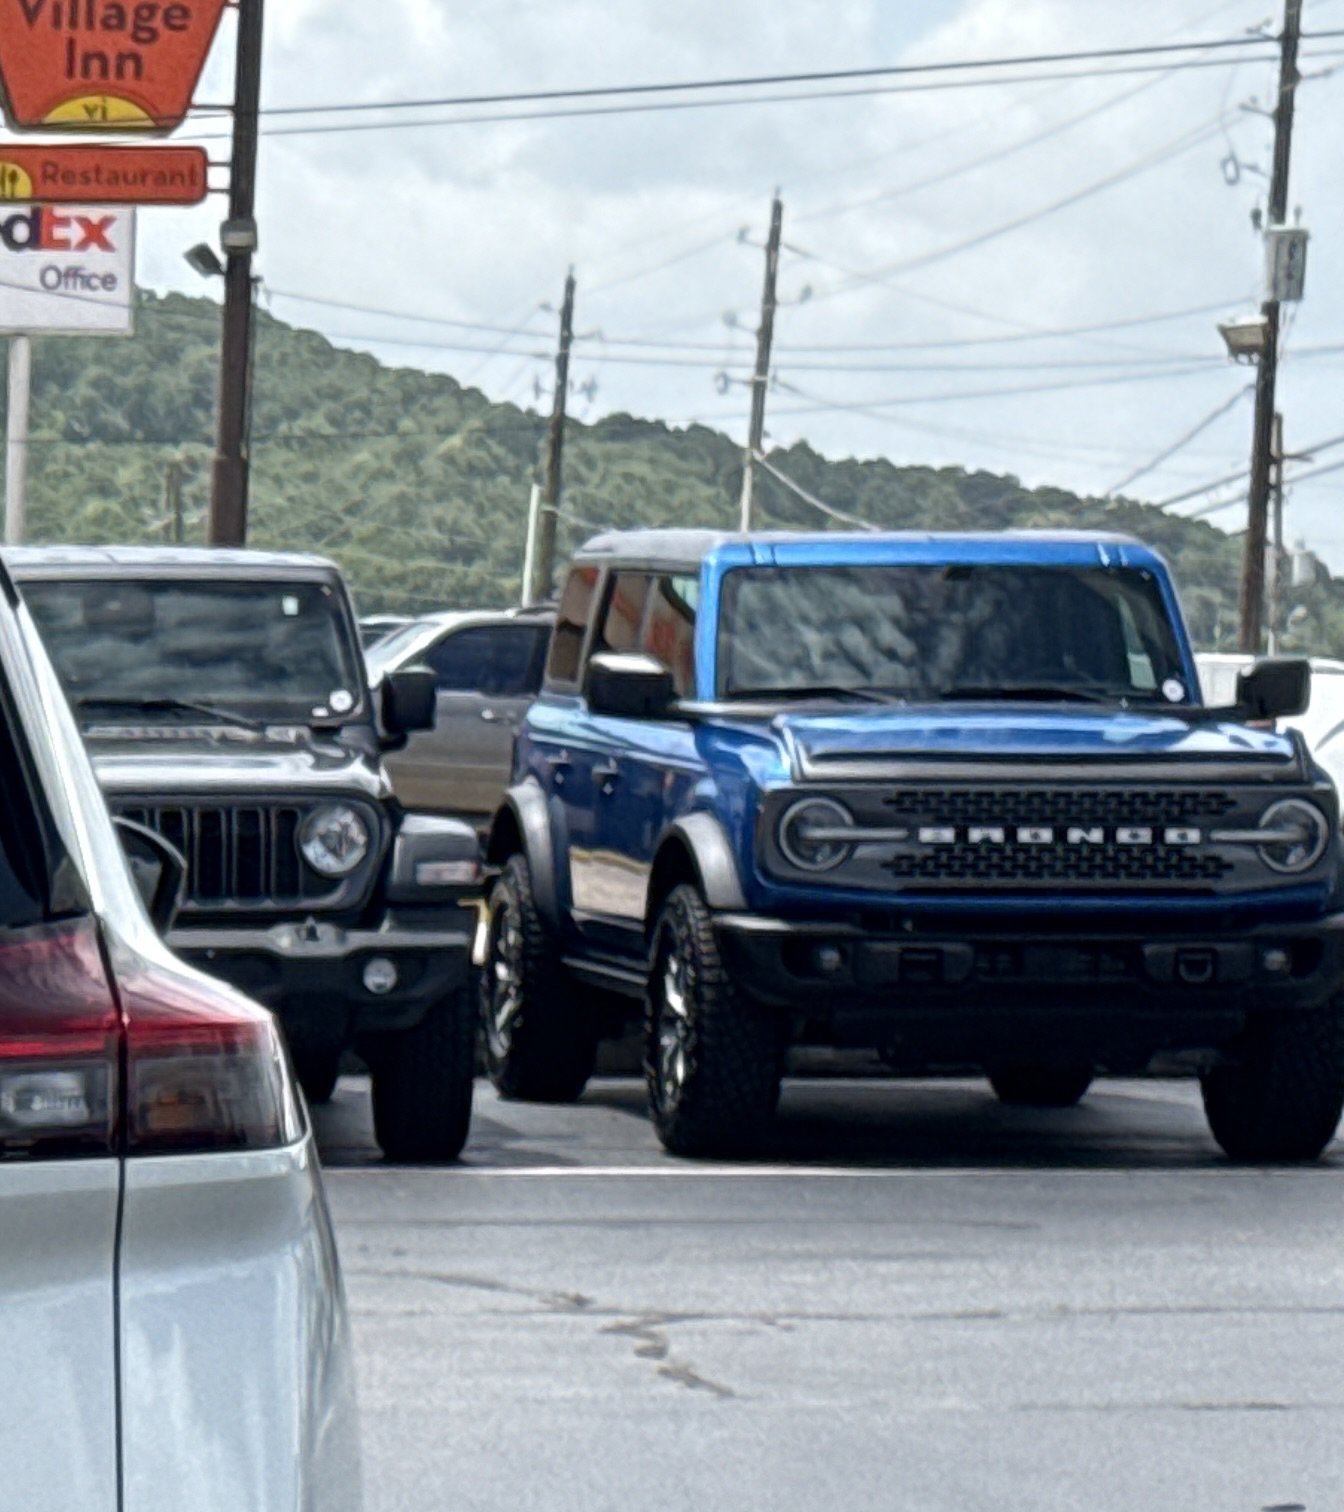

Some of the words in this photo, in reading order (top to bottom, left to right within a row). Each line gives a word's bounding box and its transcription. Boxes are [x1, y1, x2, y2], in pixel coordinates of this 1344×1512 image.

[19, 0, 192, 44] Village
[65, 36, 144, 81] Inn
[42, 160, 198, 187] Restaurant
[39, 264, 118, 292] Office
[918, 826, 1201, 845] BRONCO
